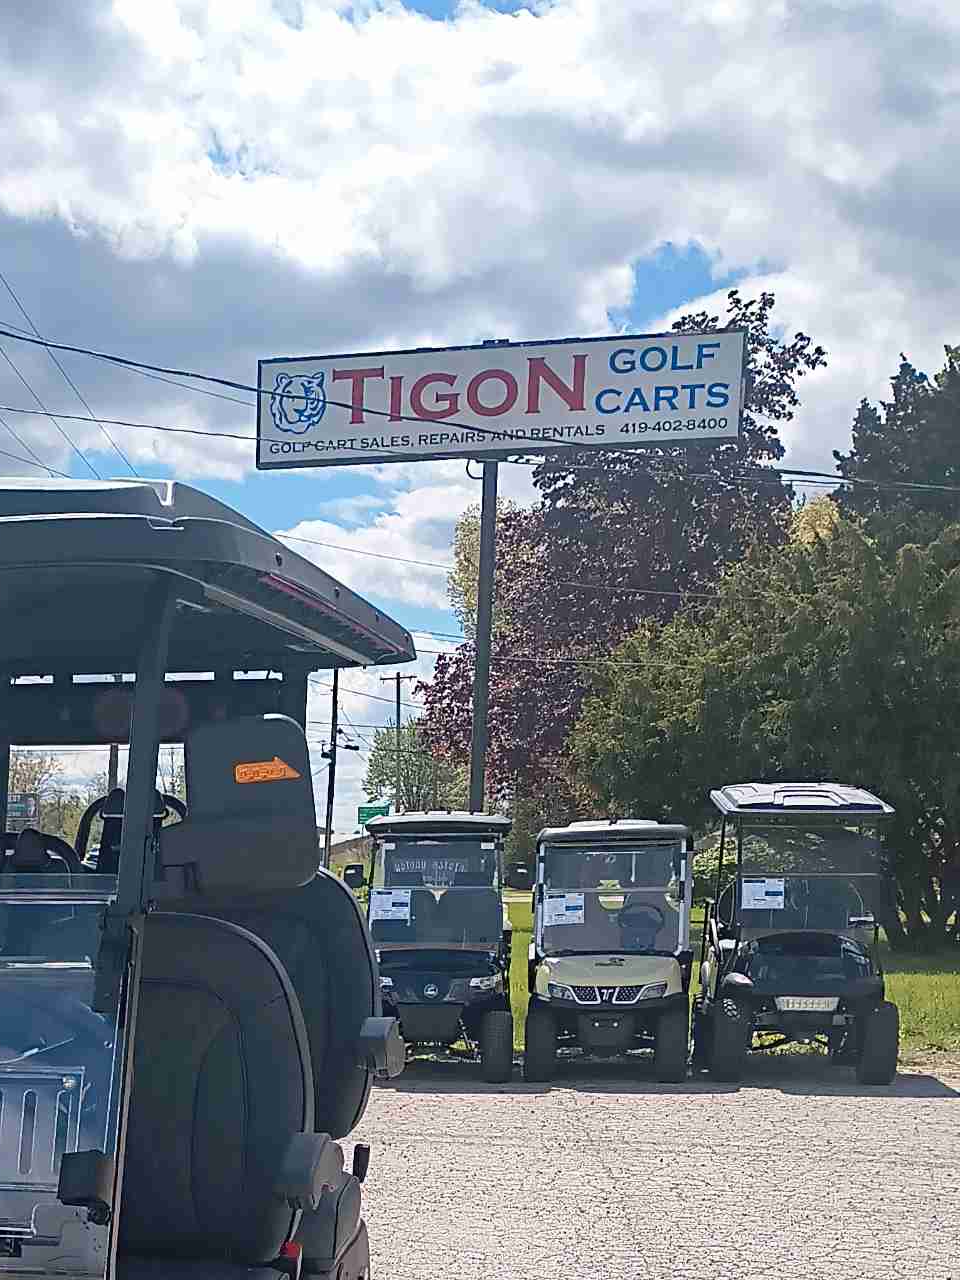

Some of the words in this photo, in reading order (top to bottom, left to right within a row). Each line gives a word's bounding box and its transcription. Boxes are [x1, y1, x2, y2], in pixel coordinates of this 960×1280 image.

[608, 343, 721, 375] GOLF
[331, 353, 590, 425] TIGON
[594, 382, 731, 415] CARTS
[269, 440, 313, 454] GOLF
[314, 438, 357, 451] CART
[360, 436, 415, 449] SALES,
[418, 432, 486, 446] REPAIRS
[491, 429, 527, 441] AND
[531, 424, 606, 439] RENTALS
[620, 416, 729, 434] 419-402-8400
